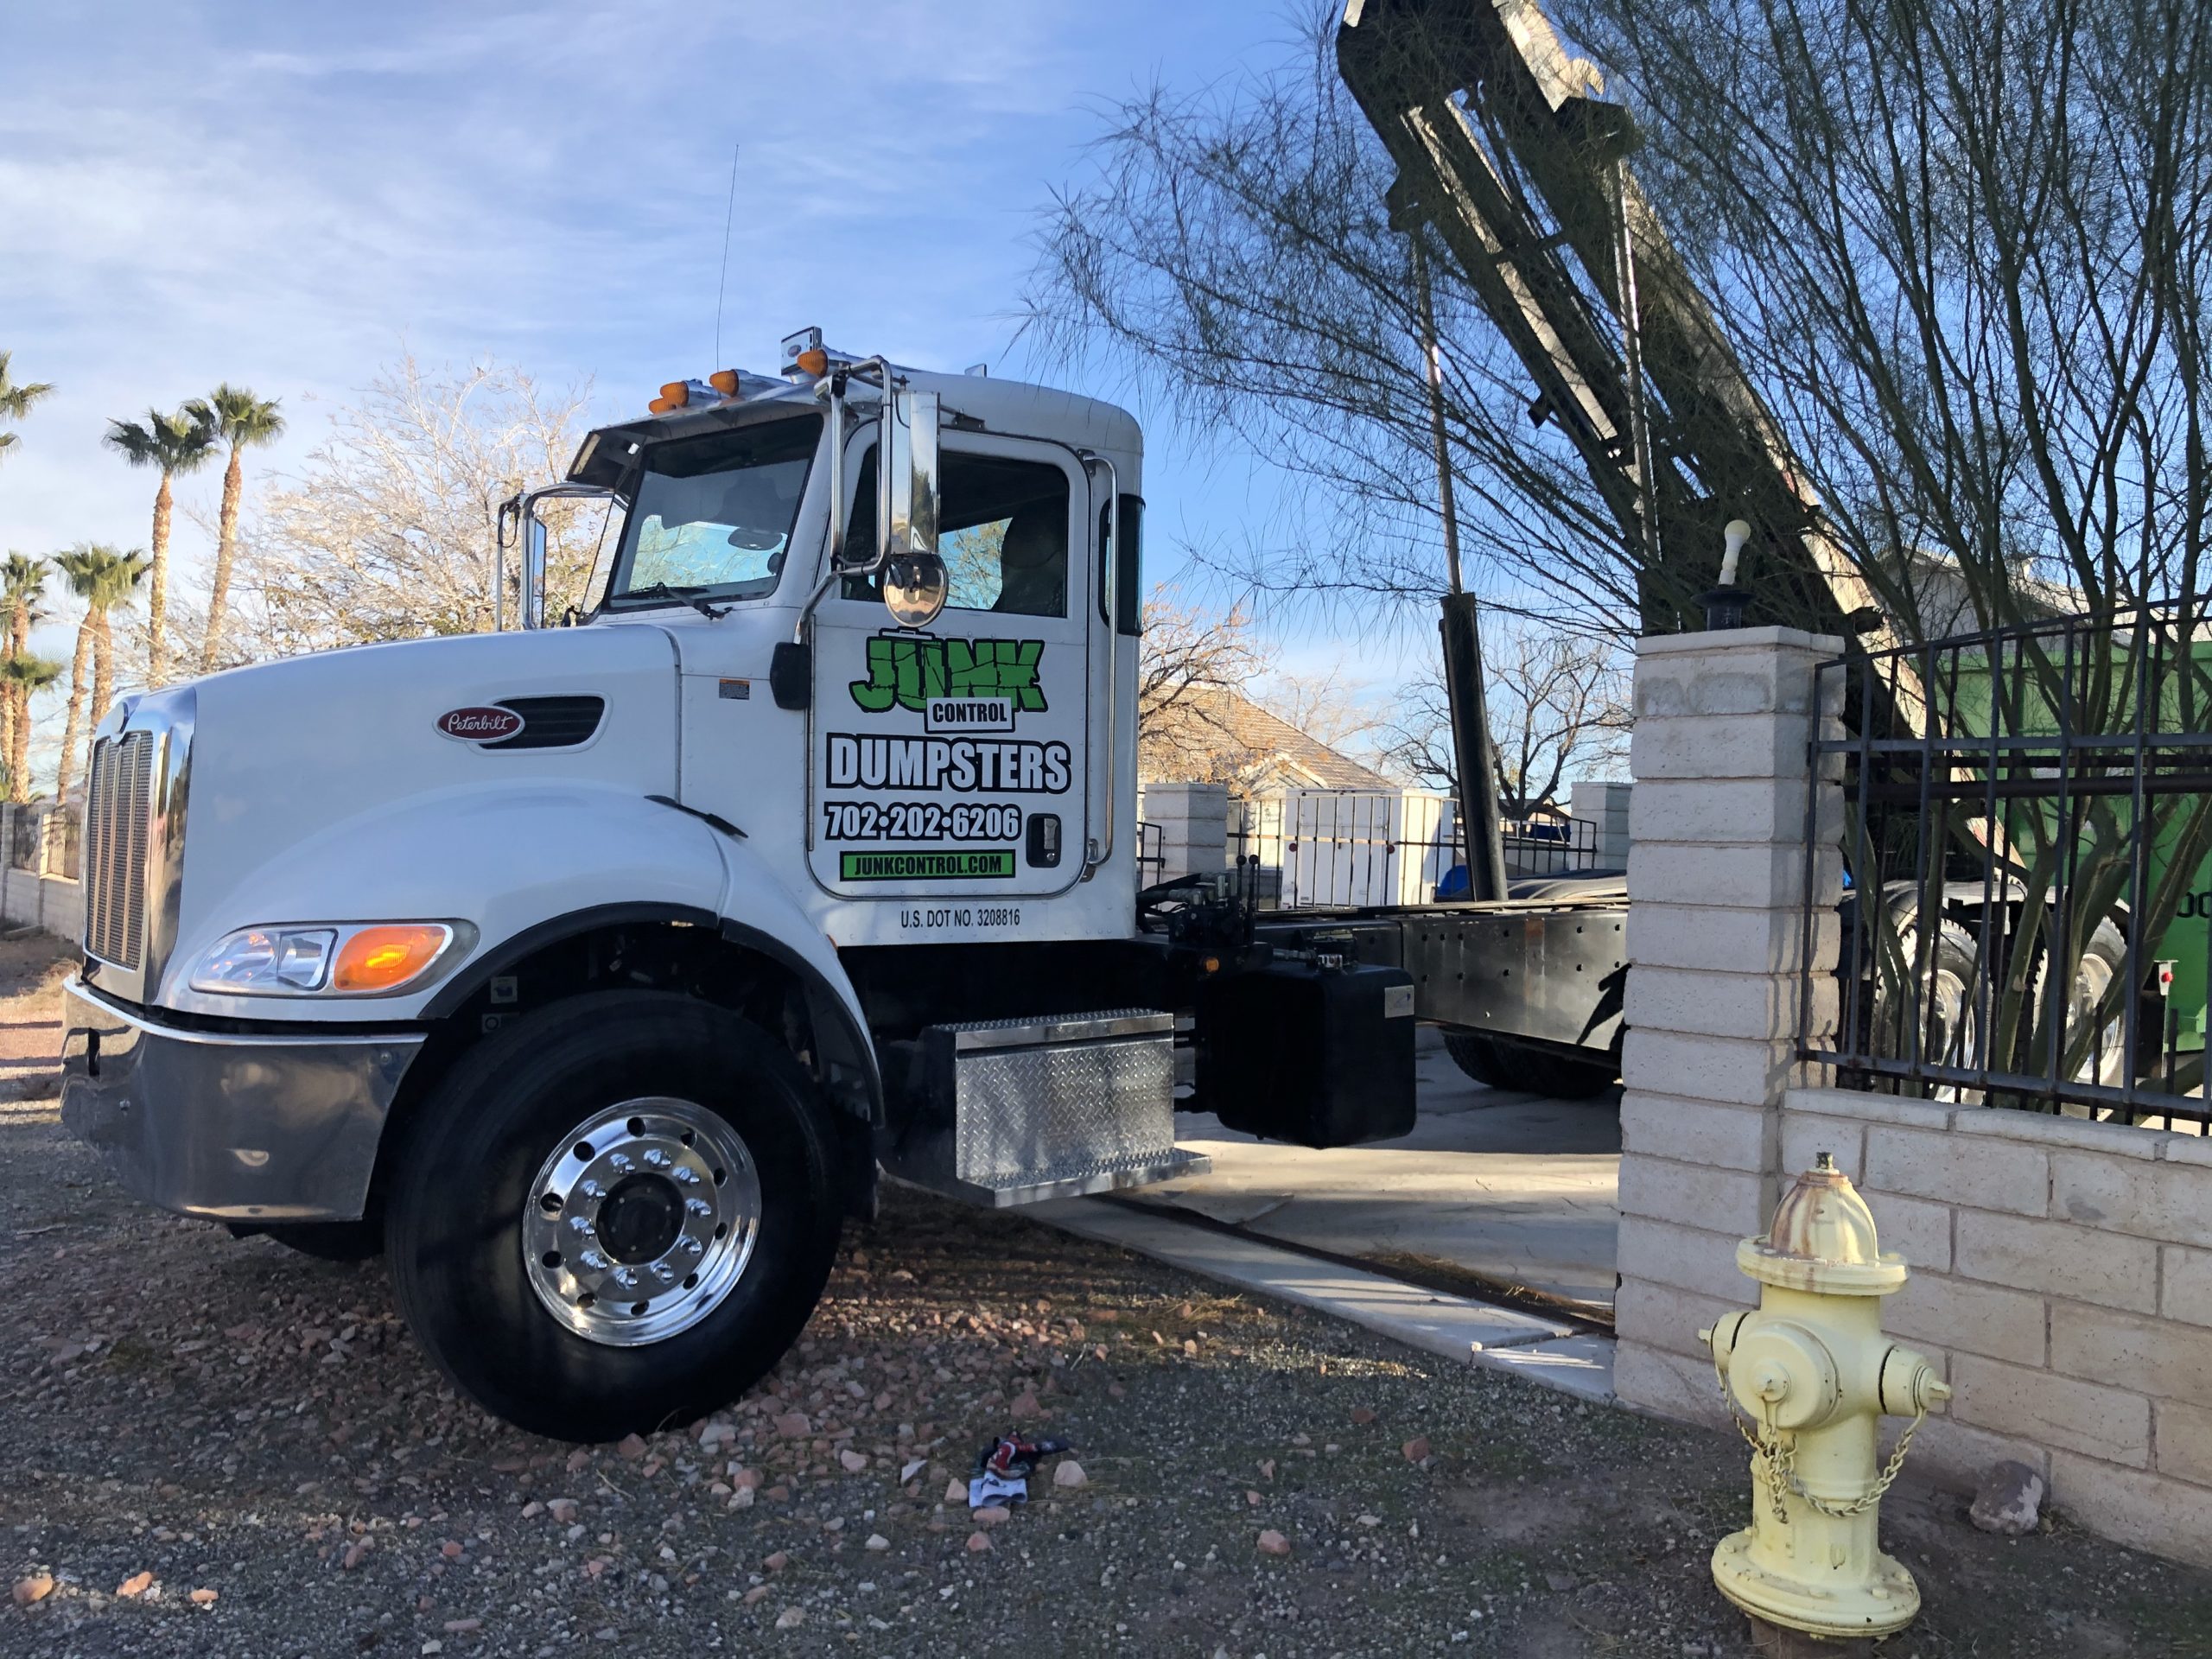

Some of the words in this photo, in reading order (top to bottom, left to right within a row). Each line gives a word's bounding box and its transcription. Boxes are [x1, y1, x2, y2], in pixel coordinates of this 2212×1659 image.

[850, 638, 1048, 713] JUNK
[448, 713, 513, 732] Peterbilt
[932, 703, 1007, 722] CONTROL
[828, 734, 1071, 793] DUMPSTERS
[855, 855, 1002, 875] JUNKCONTROL.COM
[901, 910, 923, 928] U.S.
[927, 910, 950, 927] DOT
[954, 909, 974, 927] NO.
[977, 908, 1020, 926] 3208816
